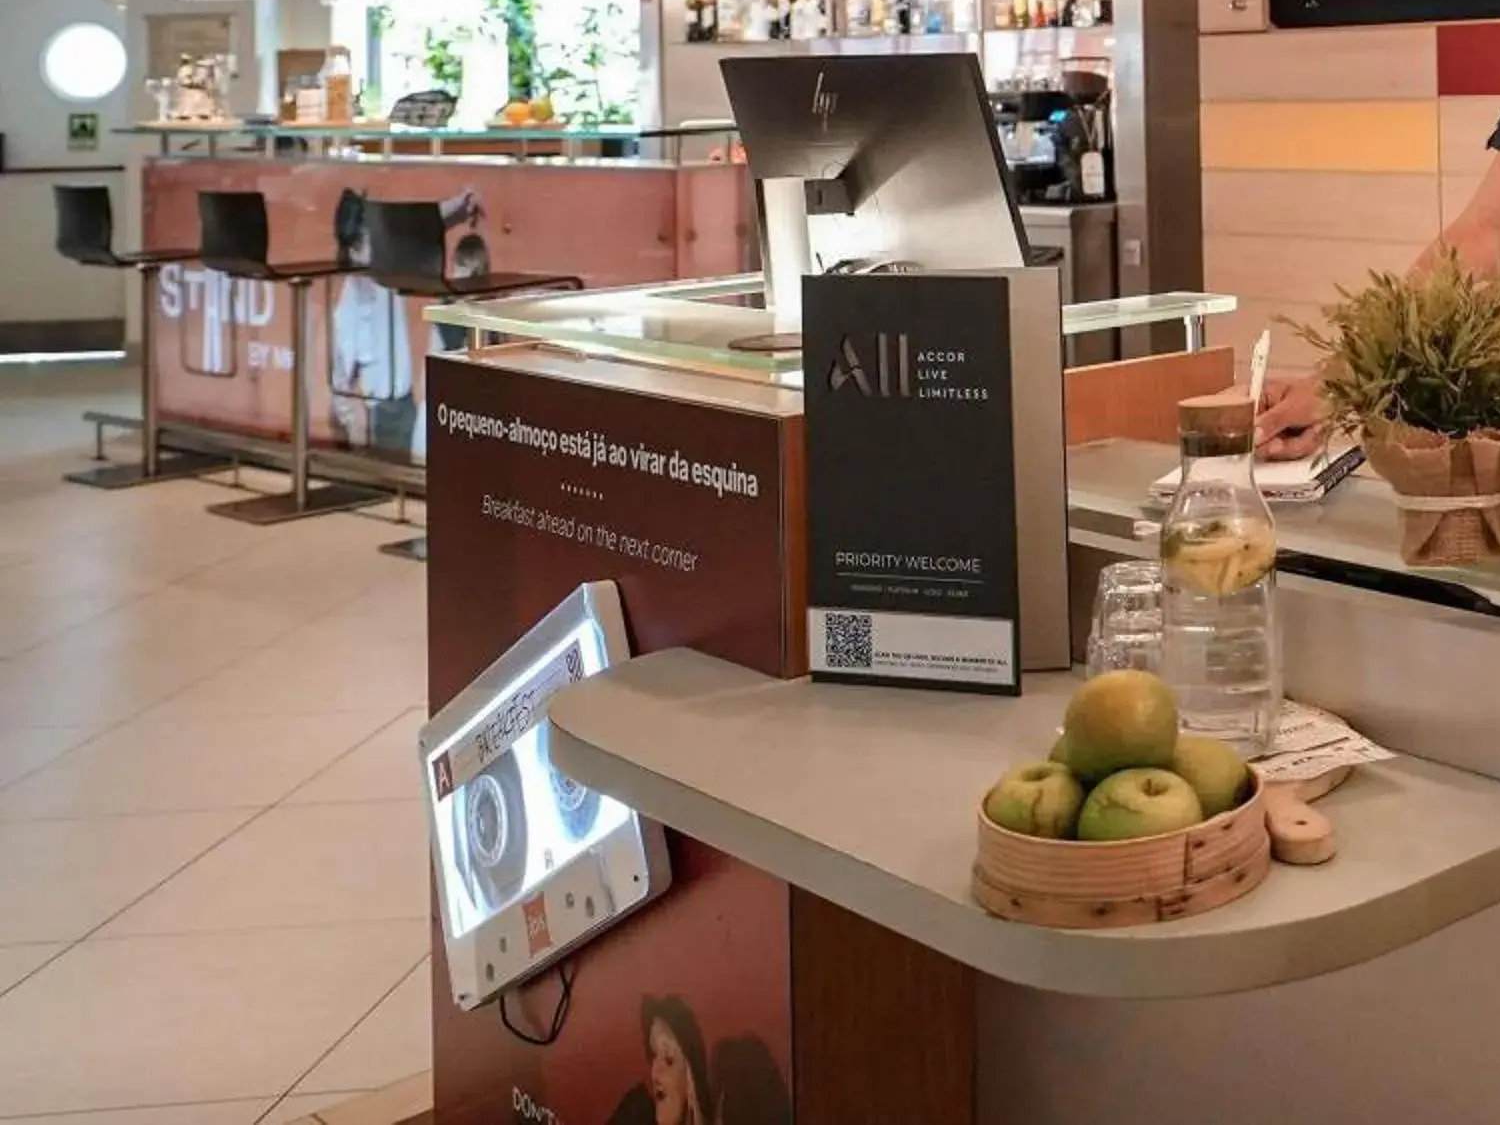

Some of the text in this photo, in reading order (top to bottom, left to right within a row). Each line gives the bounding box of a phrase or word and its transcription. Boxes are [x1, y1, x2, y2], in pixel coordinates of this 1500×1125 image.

[917, 351, 966, 362] ACCOR
[917, 370, 948, 380] LIVE
[919, 387, 988, 399] LIMITLESS
[437, 403, 758, 498] O pequeno-almoço está já ao virar da esquina
[482, 493, 699, 571] Breakfast ahead on the next corner
[835, 552, 983, 573] PRIORITY WELCOME
